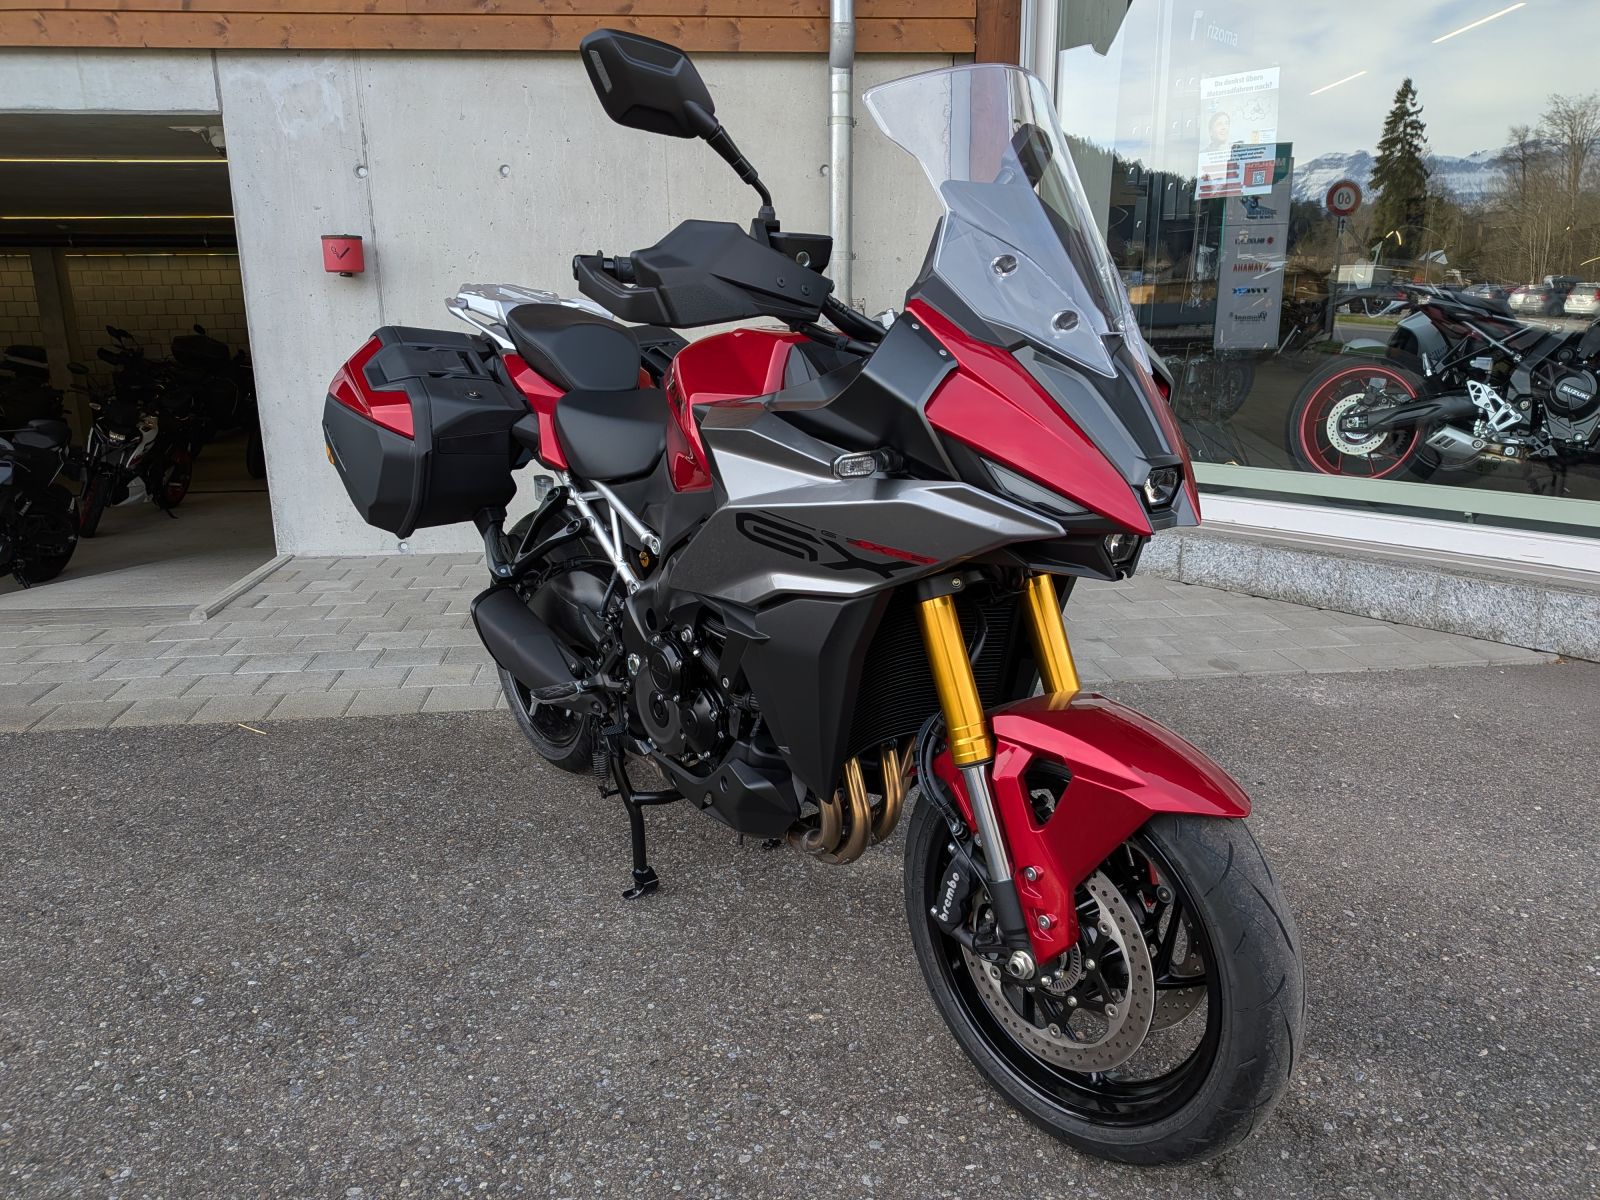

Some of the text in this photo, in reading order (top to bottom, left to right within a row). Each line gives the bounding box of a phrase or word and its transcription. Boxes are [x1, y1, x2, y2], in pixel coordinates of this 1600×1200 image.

[1207, 20, 1238, 48] rizoma
[1562, 386, 1590, 400] SUZUKI
[939, 872, 960, 922] brembo
